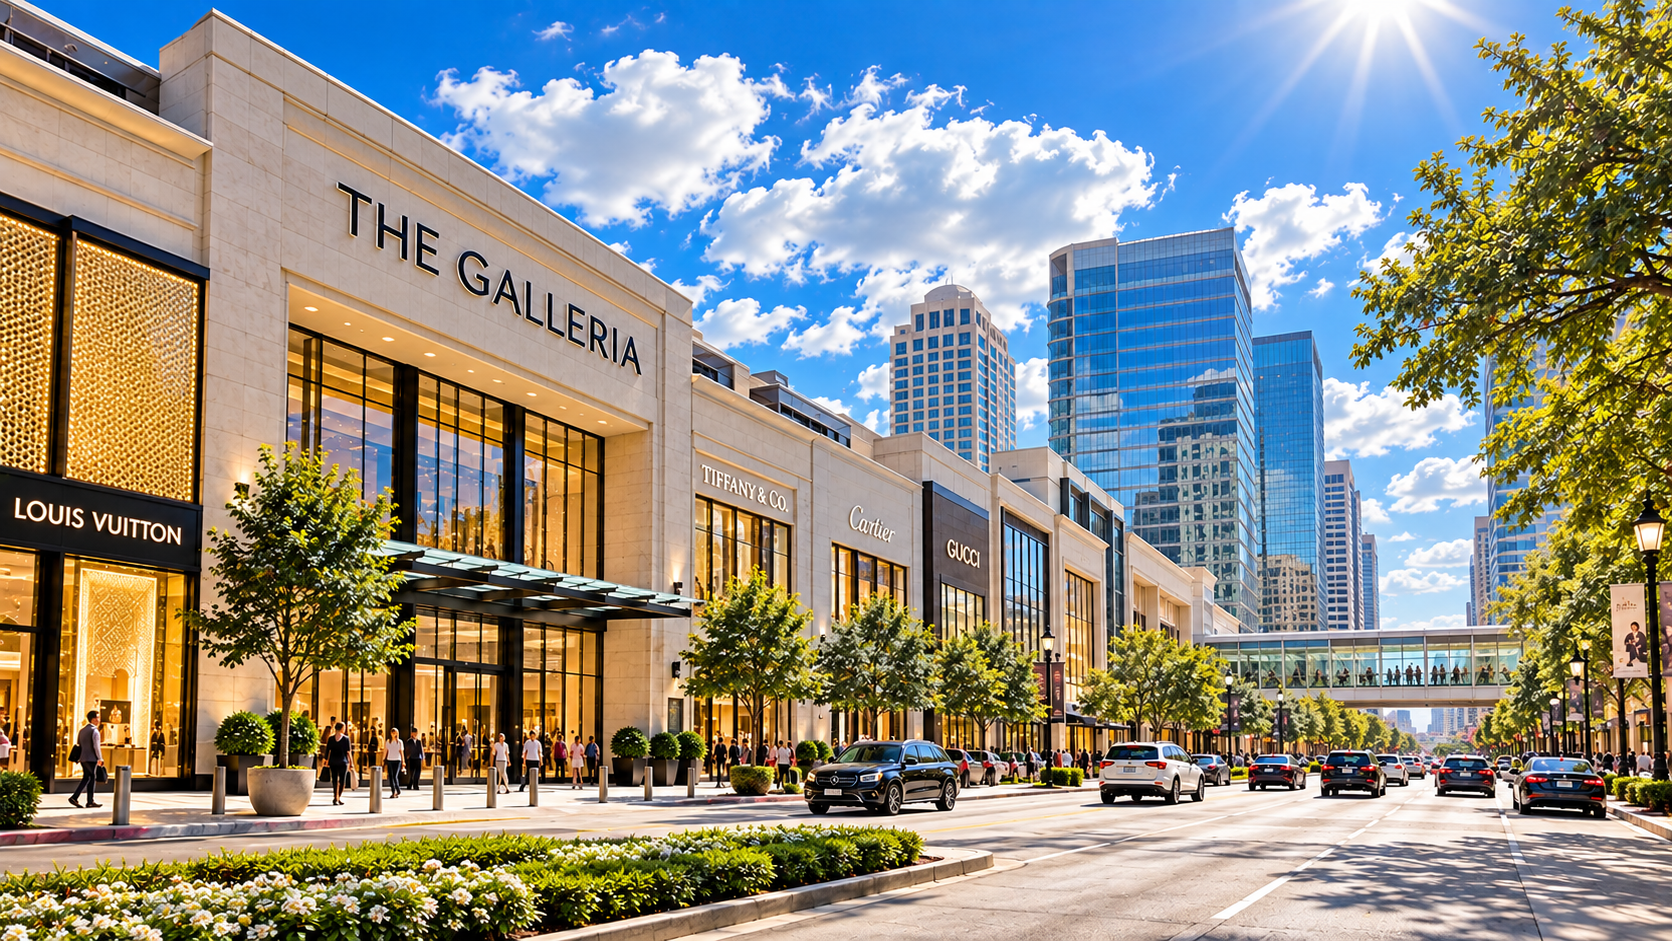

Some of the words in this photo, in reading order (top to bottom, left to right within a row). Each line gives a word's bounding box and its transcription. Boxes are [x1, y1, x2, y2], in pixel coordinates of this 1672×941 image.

[336, 181, 440, 276] THE
[457, 250, 641, 376] GALLERIA
[701, 464, 756, 502] TIFFANY
[757, 486, 767, 505] &
[769, 489, 790, 513] CO.
[15, 497, 84, 528] LOUIS
[92, 512, 182, 545] VUITTON
[849, 504, 896, 543] Cartier
[946, 538, 980, 568] GUCCI
